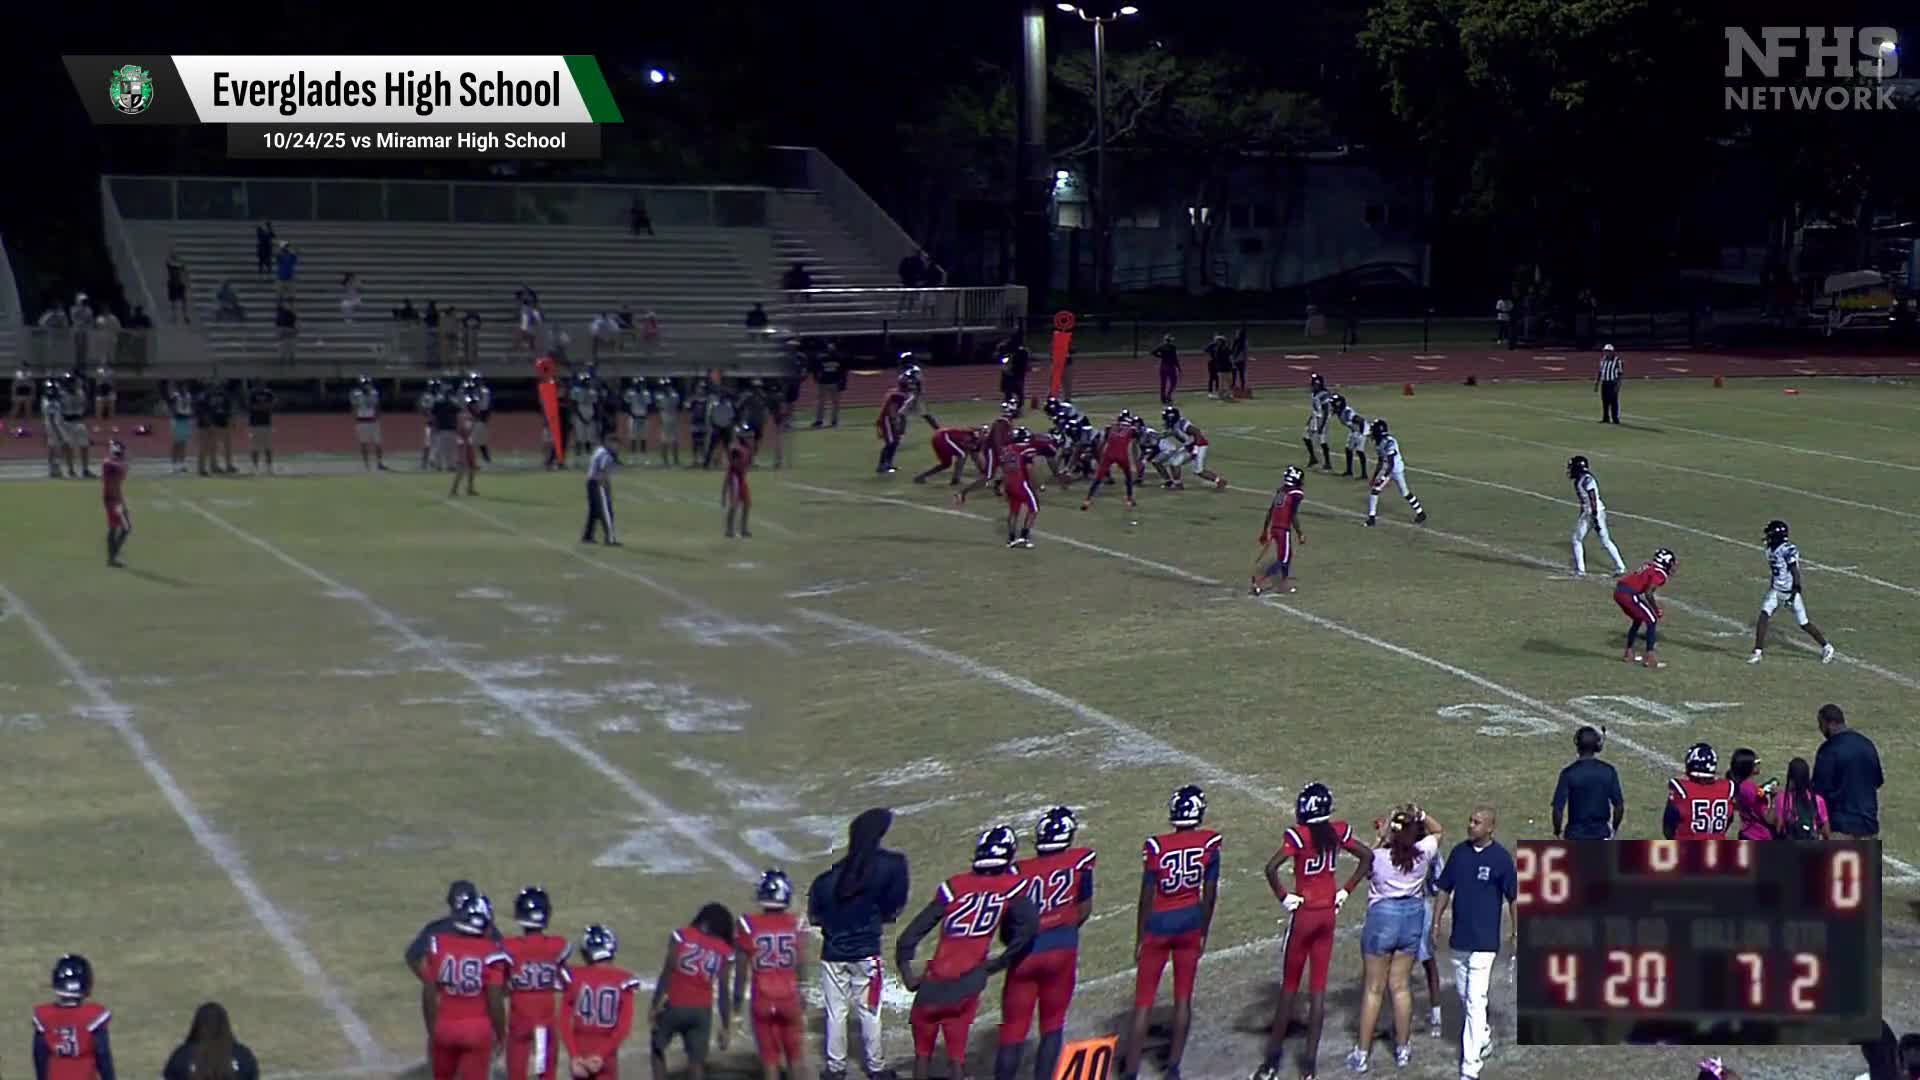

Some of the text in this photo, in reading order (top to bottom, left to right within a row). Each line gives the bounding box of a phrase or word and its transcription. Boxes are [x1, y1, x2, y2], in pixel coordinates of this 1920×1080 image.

[1691, 799, 1729, 834] 58
[1027, 867, 1075, 915] 42
[1159, 847, 1205, 894] 35
[1517, 846, 1570, 905] 26
[1830, 850, 1863, 908] 0
[943, 891, 1006, 937] 26
[679, 945, 722, 977] 24
[753, 933, 797, 971] 25
[438, 954, 482, 996] 48
[1546, 951, 1821, 1011] 4 20 7 2
[575, 984, 621, 1029] 40
[54, 1027, 80, 1058] 3
